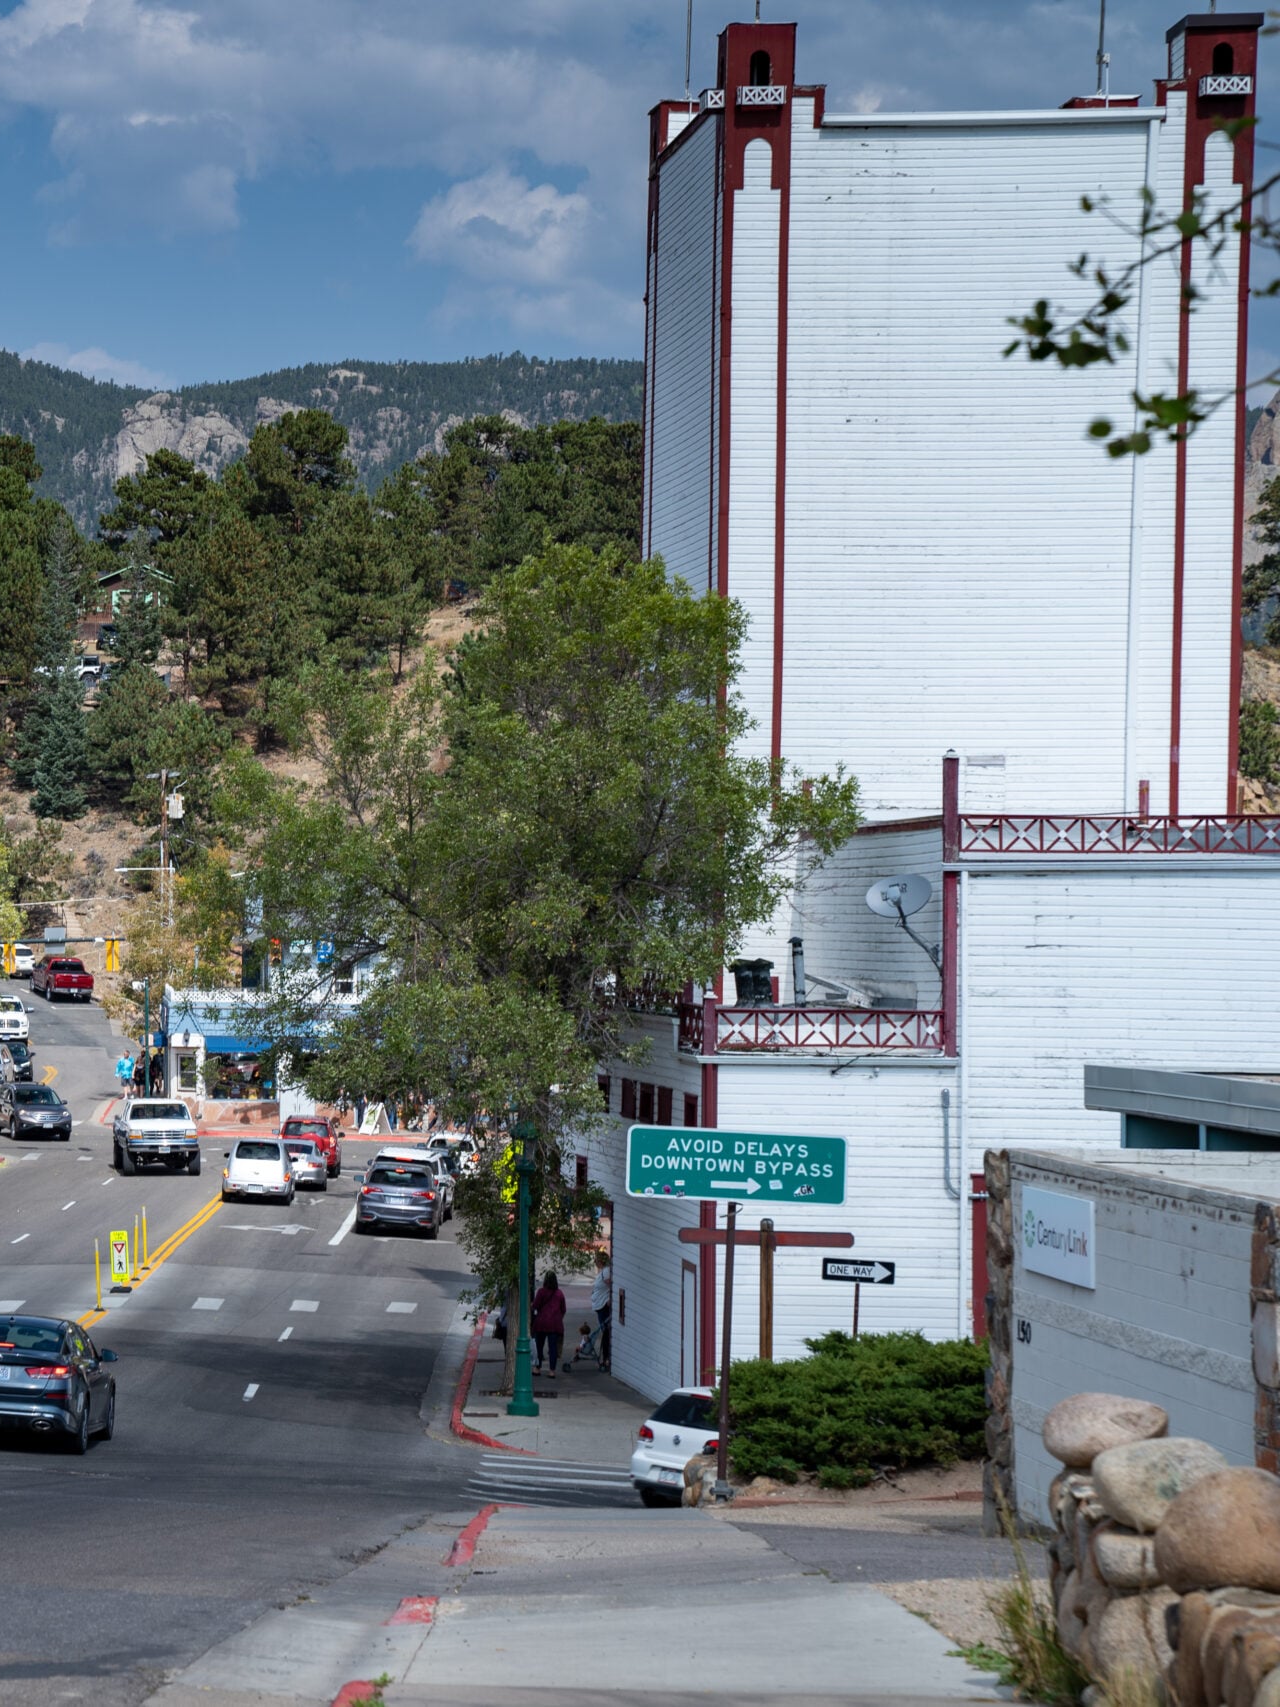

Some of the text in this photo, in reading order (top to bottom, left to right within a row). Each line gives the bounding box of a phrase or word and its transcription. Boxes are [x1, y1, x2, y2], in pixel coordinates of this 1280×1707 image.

[667, 1138, 809, 1158] AVOID DELAYS
[641, 1154, 834, 1178] DOWNTOWN BYPASS
[1037, 1220, 1088, 1257] CenturyLink
[829, 1264, 874, 1276] ONE WAY
